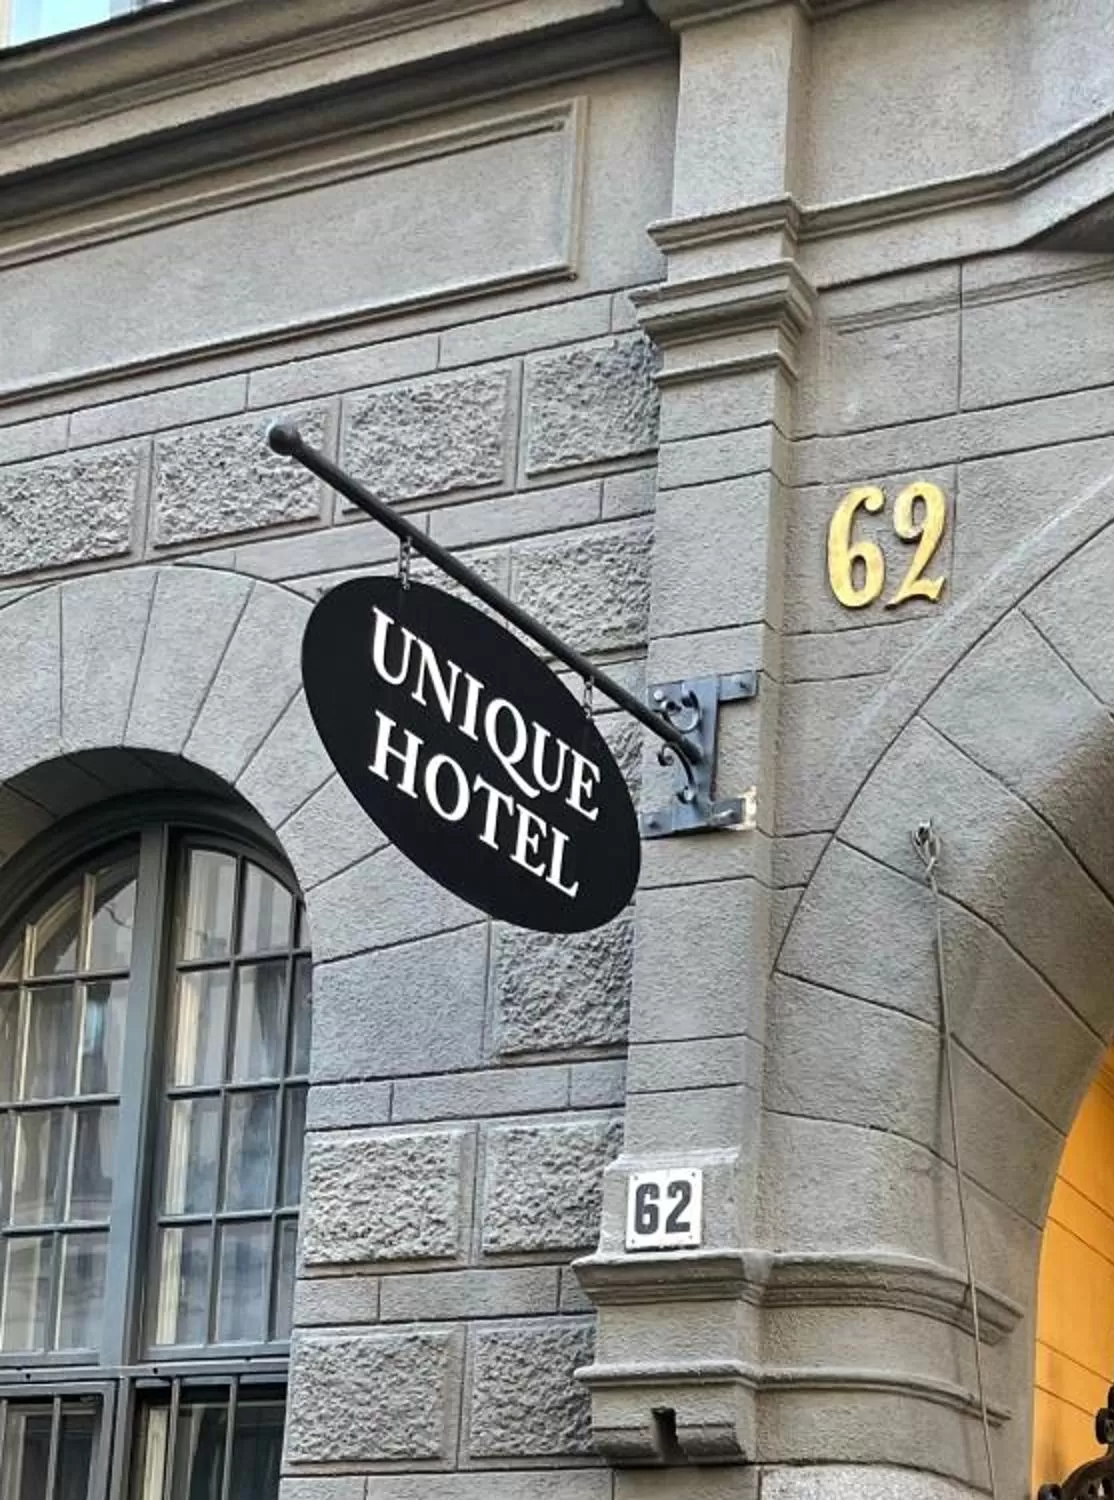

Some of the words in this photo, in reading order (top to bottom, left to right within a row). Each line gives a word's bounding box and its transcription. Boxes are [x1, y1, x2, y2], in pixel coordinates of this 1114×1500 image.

[828, 481, 946, 609] 62
[371, 606, 602, 822] UNIQUE
[368, 710, 580, 898] HOTEL
[635, 1180, 692, 1234] 62
